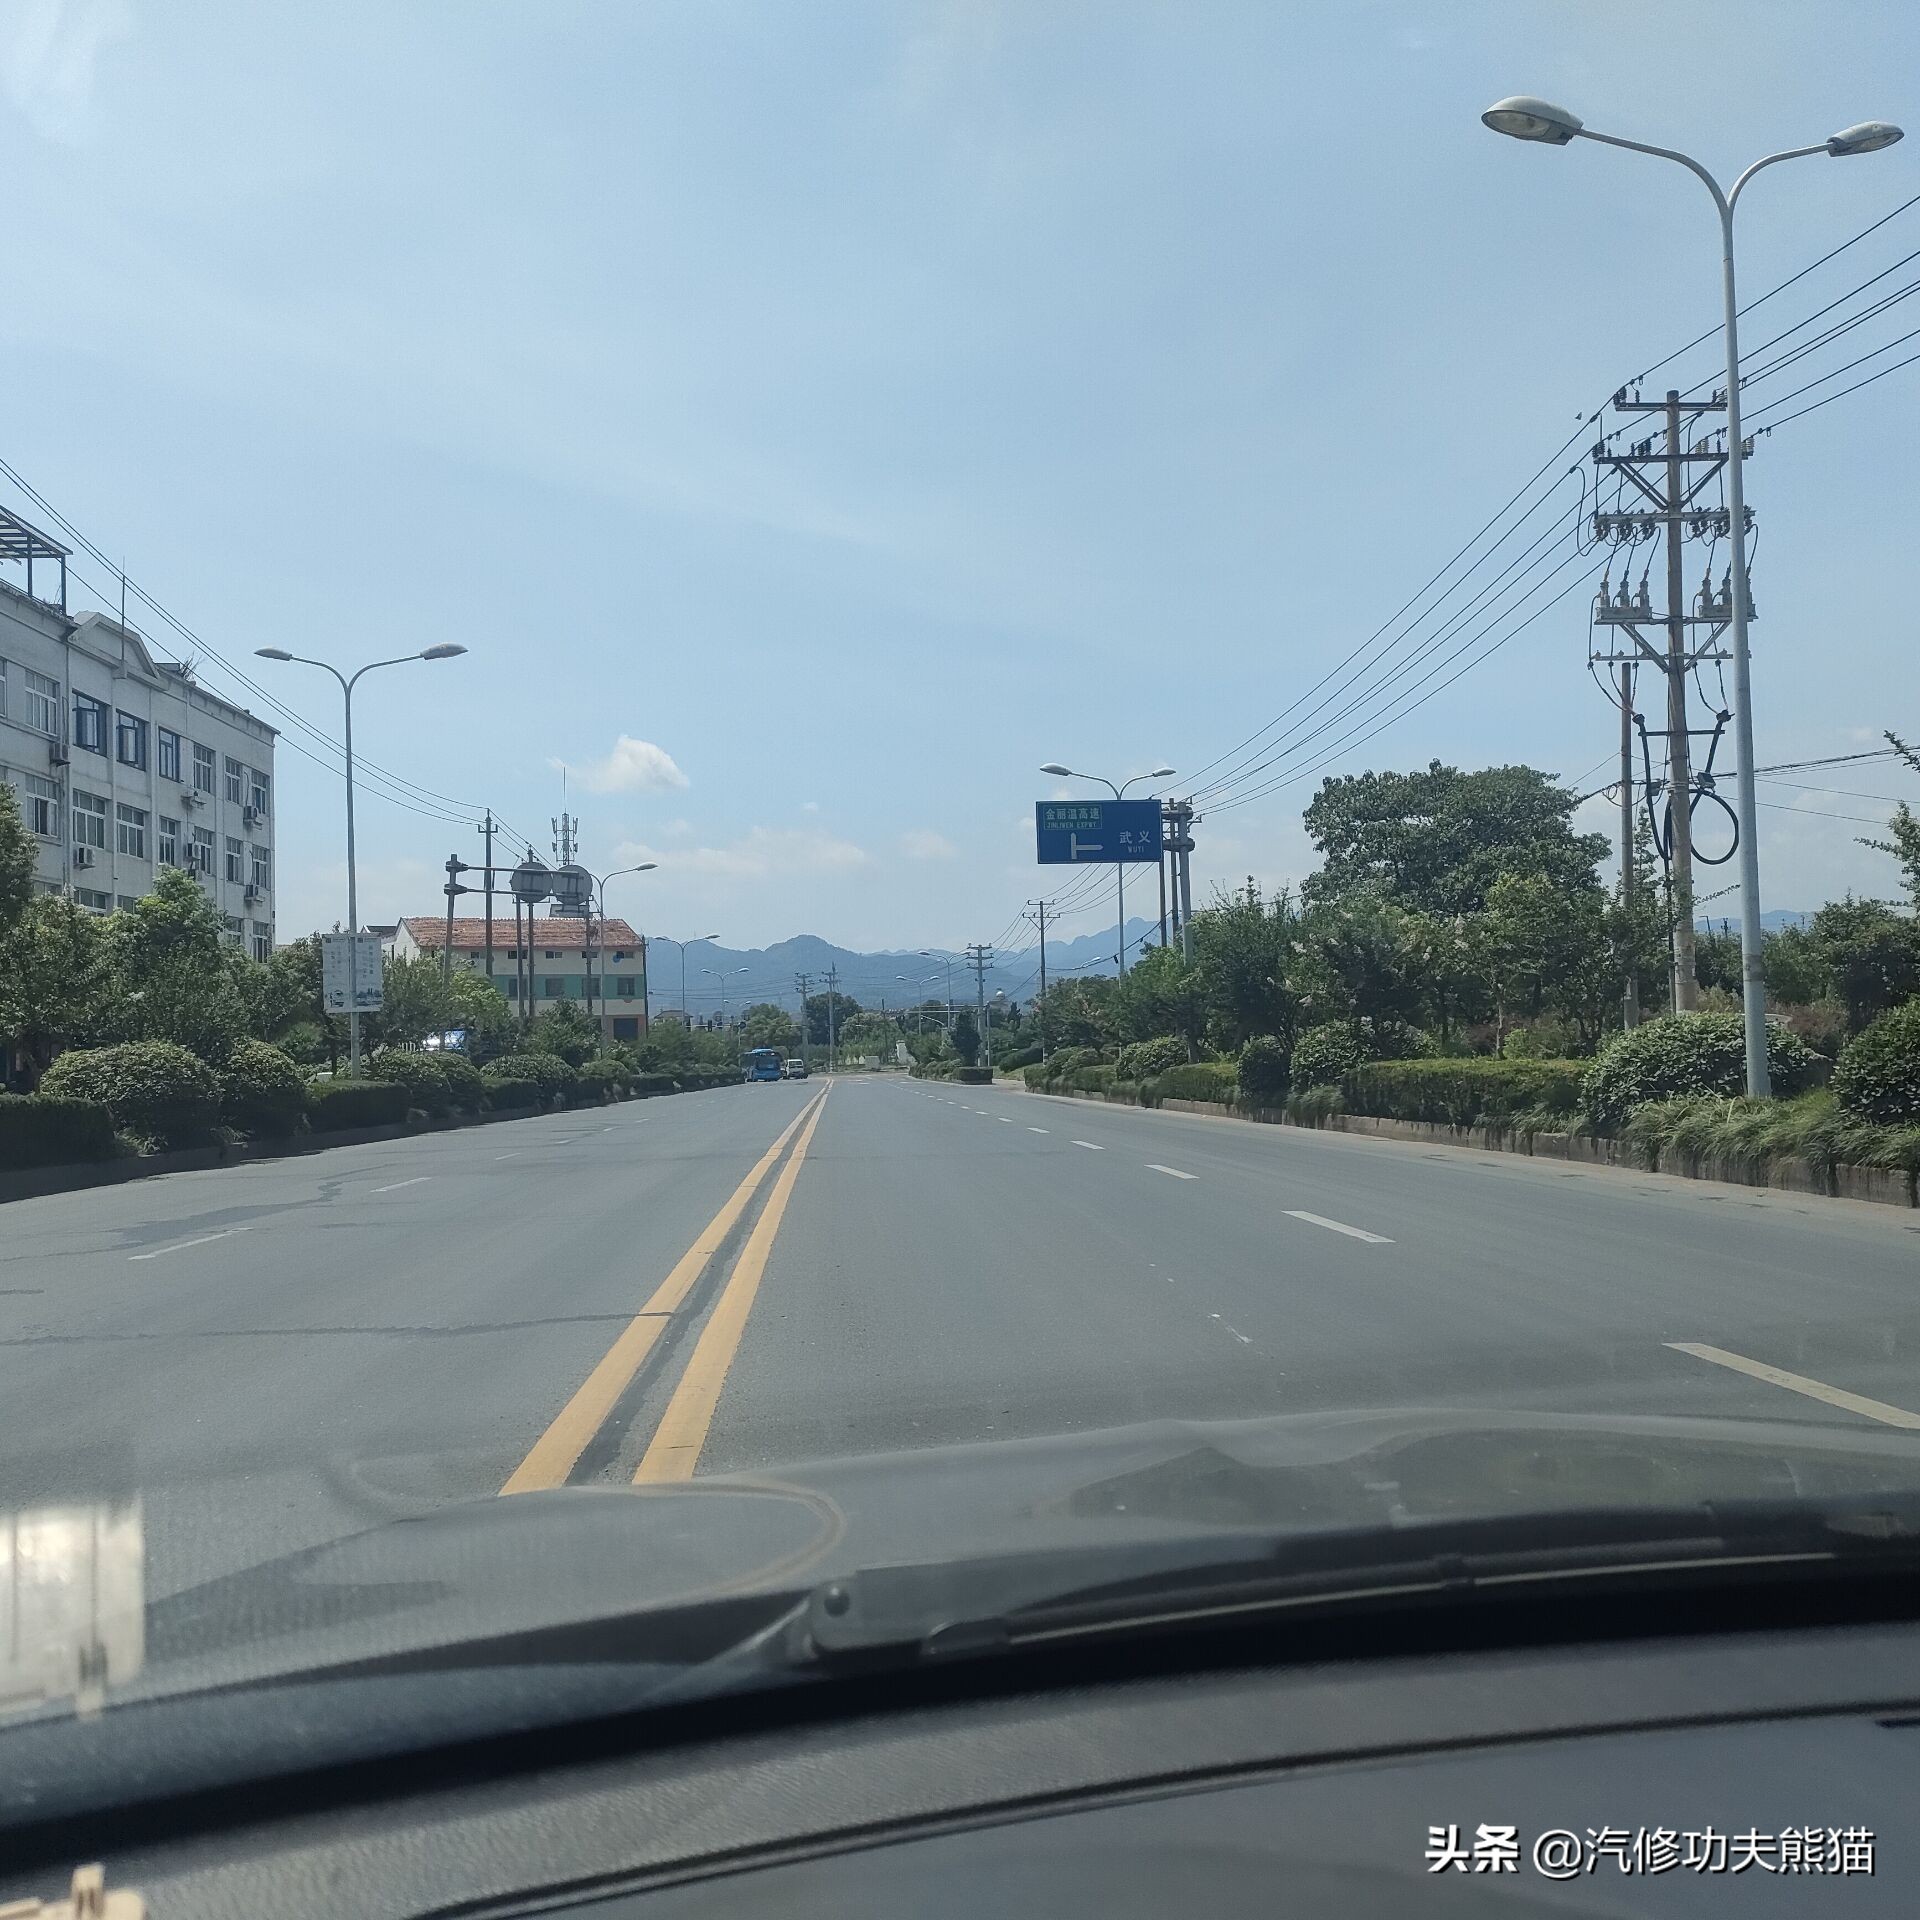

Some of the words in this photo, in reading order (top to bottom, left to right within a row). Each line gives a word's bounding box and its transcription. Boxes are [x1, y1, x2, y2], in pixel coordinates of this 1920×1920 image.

[1046, 807, 1099, 820] 金丽温高速
[1119, 830, 1151, 844] 武义
